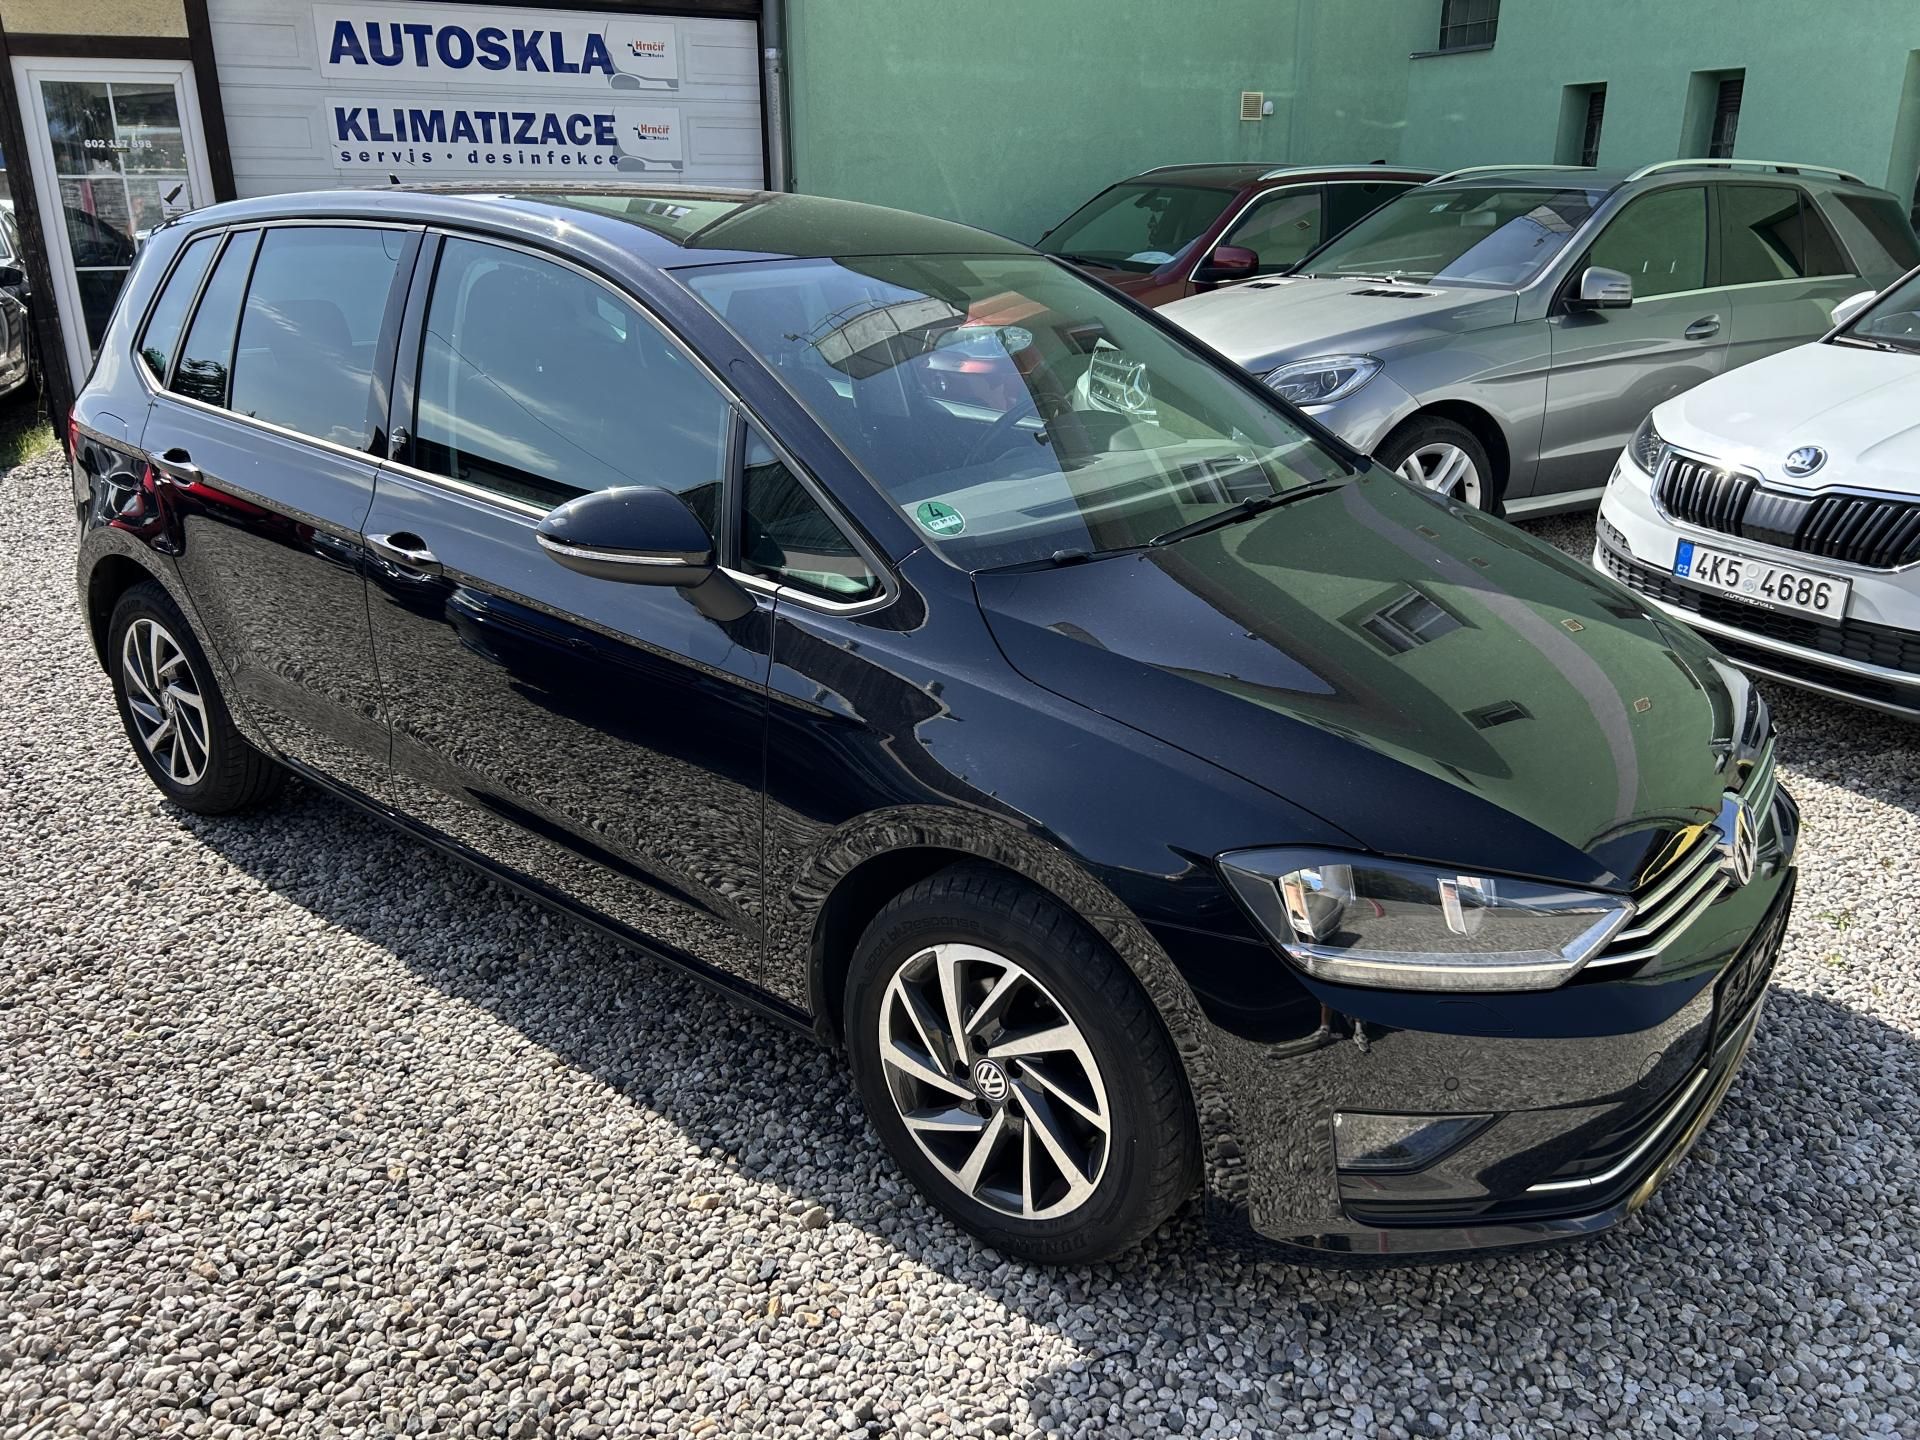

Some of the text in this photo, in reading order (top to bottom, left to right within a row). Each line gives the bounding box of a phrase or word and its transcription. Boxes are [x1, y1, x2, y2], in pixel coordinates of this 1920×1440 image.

[329, 20, 615, 75] AUTOSKLA
[334, 107, 617, 146] KLIMATIZACE
[84, 139, 106, 149] 602
[341, 149, 619, 165] servis desinfekce
[927, 503, 944, 518] 4
[1677, 552, 1832, 610] CZ 4K5 4686
